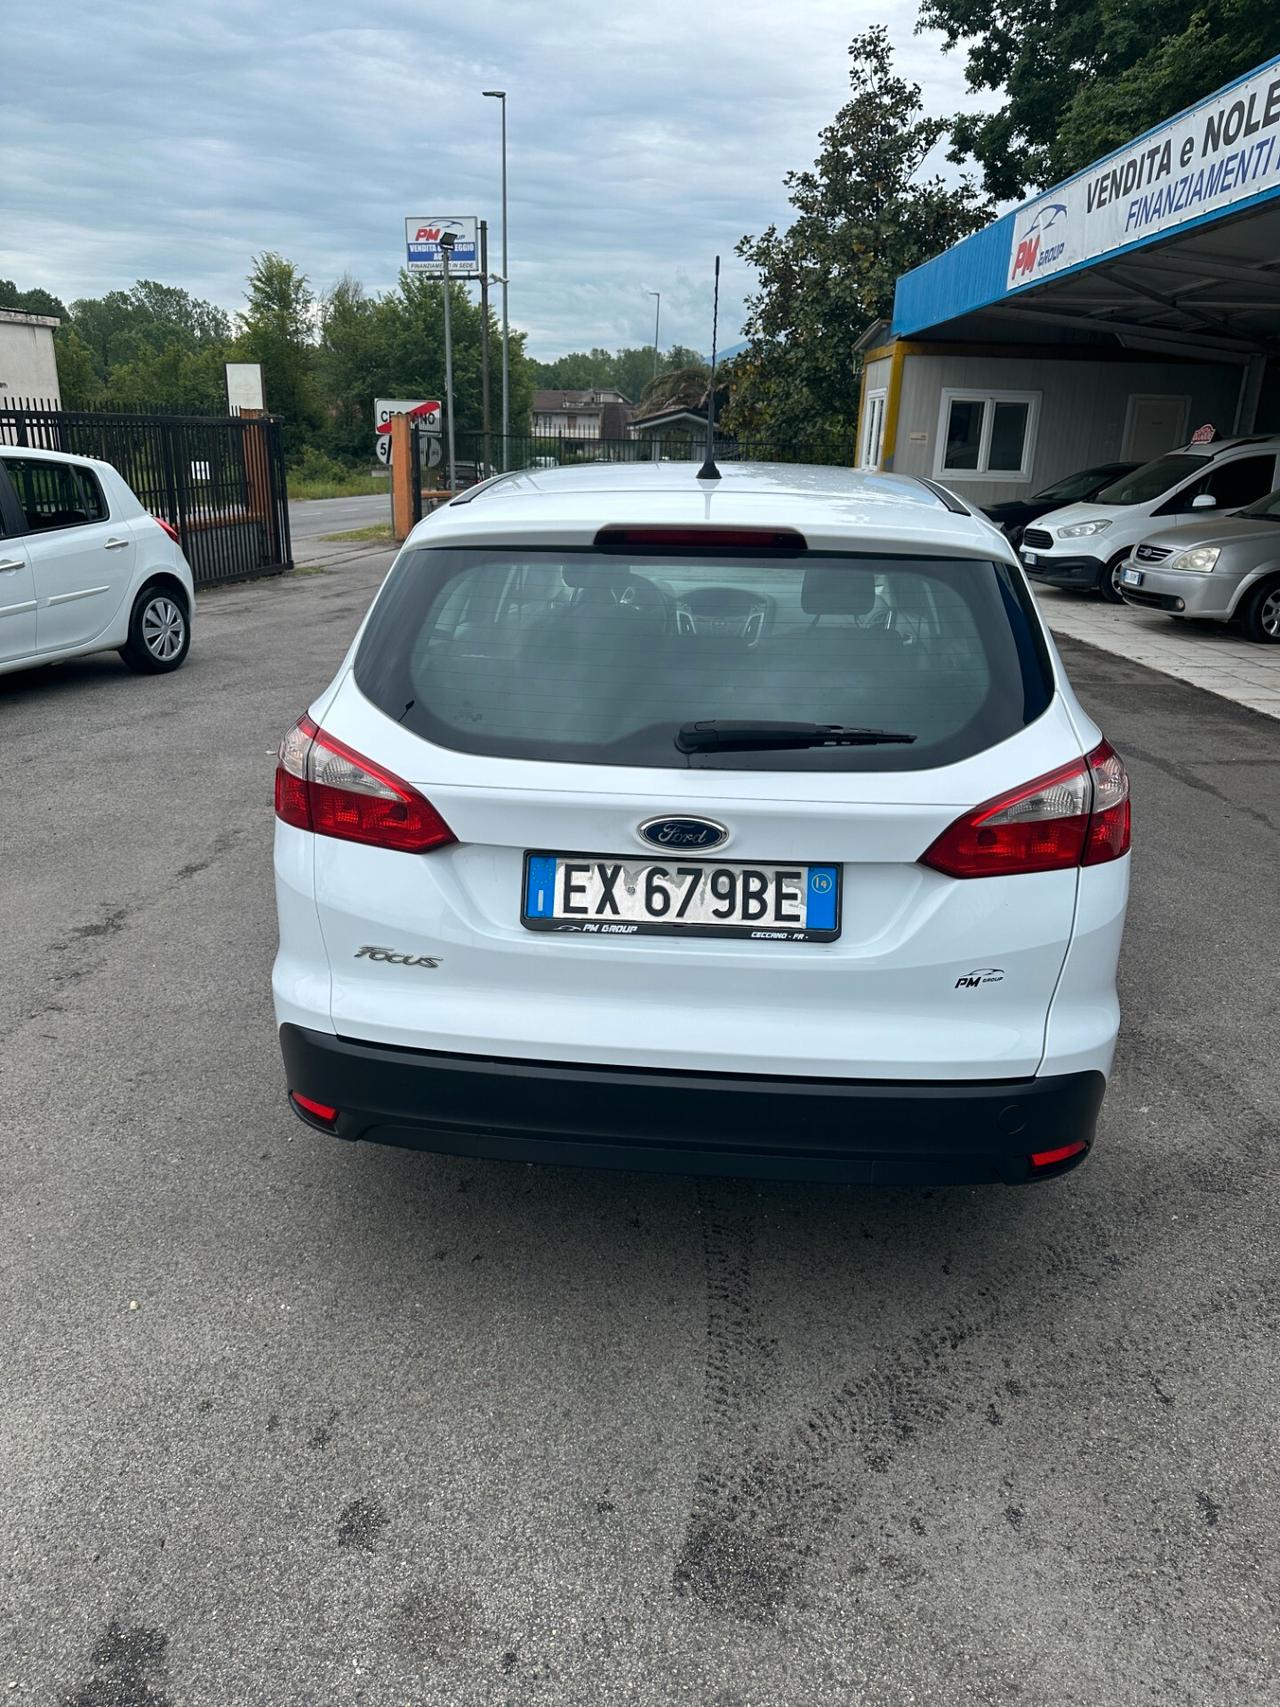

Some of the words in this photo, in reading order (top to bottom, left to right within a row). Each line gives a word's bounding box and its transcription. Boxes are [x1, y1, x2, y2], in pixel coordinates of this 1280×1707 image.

[1086, 139, 1172, 214] VENDITA
[1179, 136, 1195, 168] e
[1124, 136, 1276, 233] FINANZIAMENTI
[415, 229, 441, 241] PM
[409, 244, 436, 252] VENDITA
[1012, 235, 1040, 281] PM
[1037, 243, 1065, 267] GROUP
[658, 823, 707, 843] Ford
[563, 863, 622, 915] EX
[645, 865, 802, 923] 679BE
[583, 924, 600, 932] PM
[601, 924, 638, 933] GROUP
[751, 931, 788, 939] CECCANO
[955, 976, 981, 989] PM
